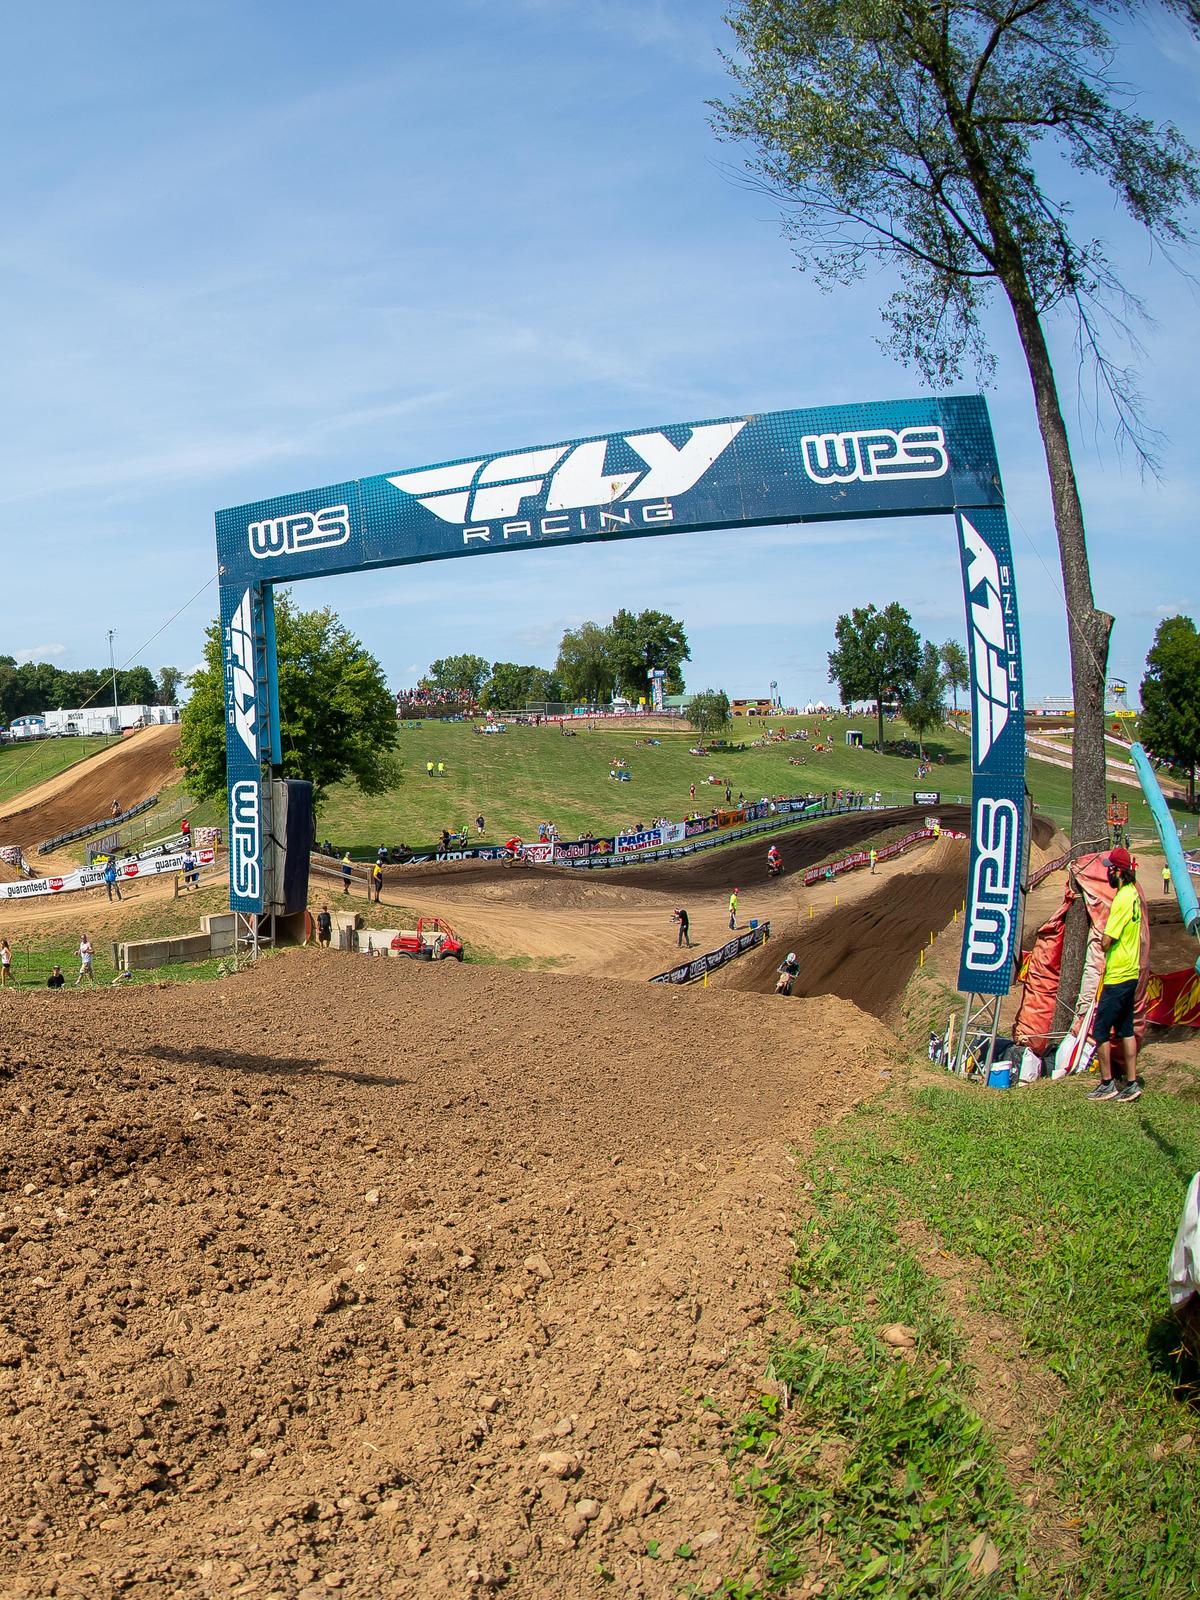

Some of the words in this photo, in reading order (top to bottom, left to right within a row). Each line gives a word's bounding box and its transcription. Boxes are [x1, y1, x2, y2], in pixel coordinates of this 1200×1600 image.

[384, 420, 749, 525] FLY
[801, 425, 950, 484] WPS
[247, 503, 351, 560] WPS
[462, 502, 676, 545] RACING
[960, 512, 1006, 766] FLY
[1001, 564, 1020, 713] RACING
[224, 626, 236, 725] RACING
[231, 587, 258, 760] FLY
[138, 846, 163, 859] GEICO
[155, 854, 198, 873] guarand
[164, 836, 190, 849] GEICO
[231, 780, 261, 899] WPS
[617, 829, 662, 846] PARTS
[618, 838, 662, 853] UNLIMITED
[7, 880, 48, 897] guaranteed
[966, 797, 1019, 973] WPS
